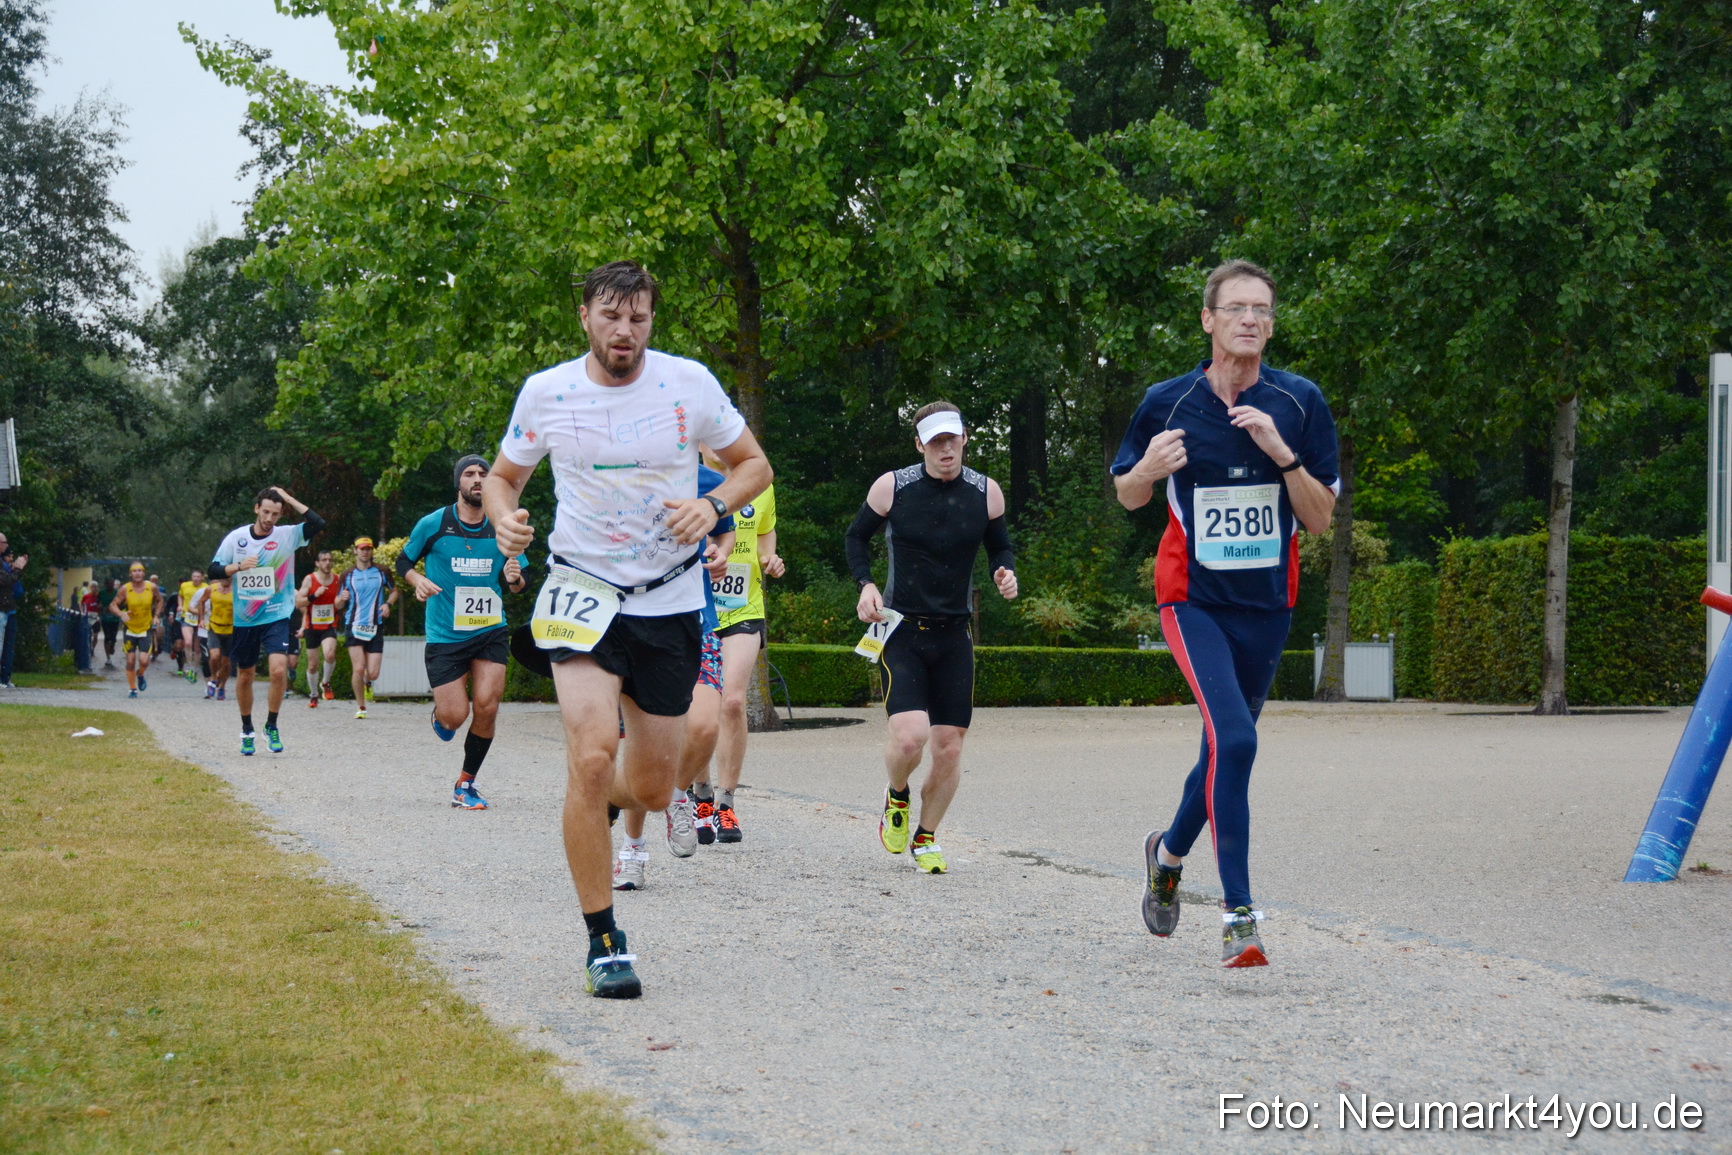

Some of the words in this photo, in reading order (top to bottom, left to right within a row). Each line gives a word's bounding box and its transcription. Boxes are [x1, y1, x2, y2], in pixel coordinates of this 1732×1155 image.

[572, 410, 657, 447] Herr
[1235, 488, 1272, 500] BOCK
[1205, 505, 1274, 538] 2580
[1223, 545, 1261, 557] Martin
[451, 557, 493, 568] HUBER
[241, 575, 271, 588] 2320
[573, 573, 616, 598] BOCK
[465, 597, 492, 614] 241
[549, 586, 599, 623] 112
[316, 609, 331, 617] 350
[469, 617, 489, 625] Daniel
[547, 624, 574, 640] Fabian
